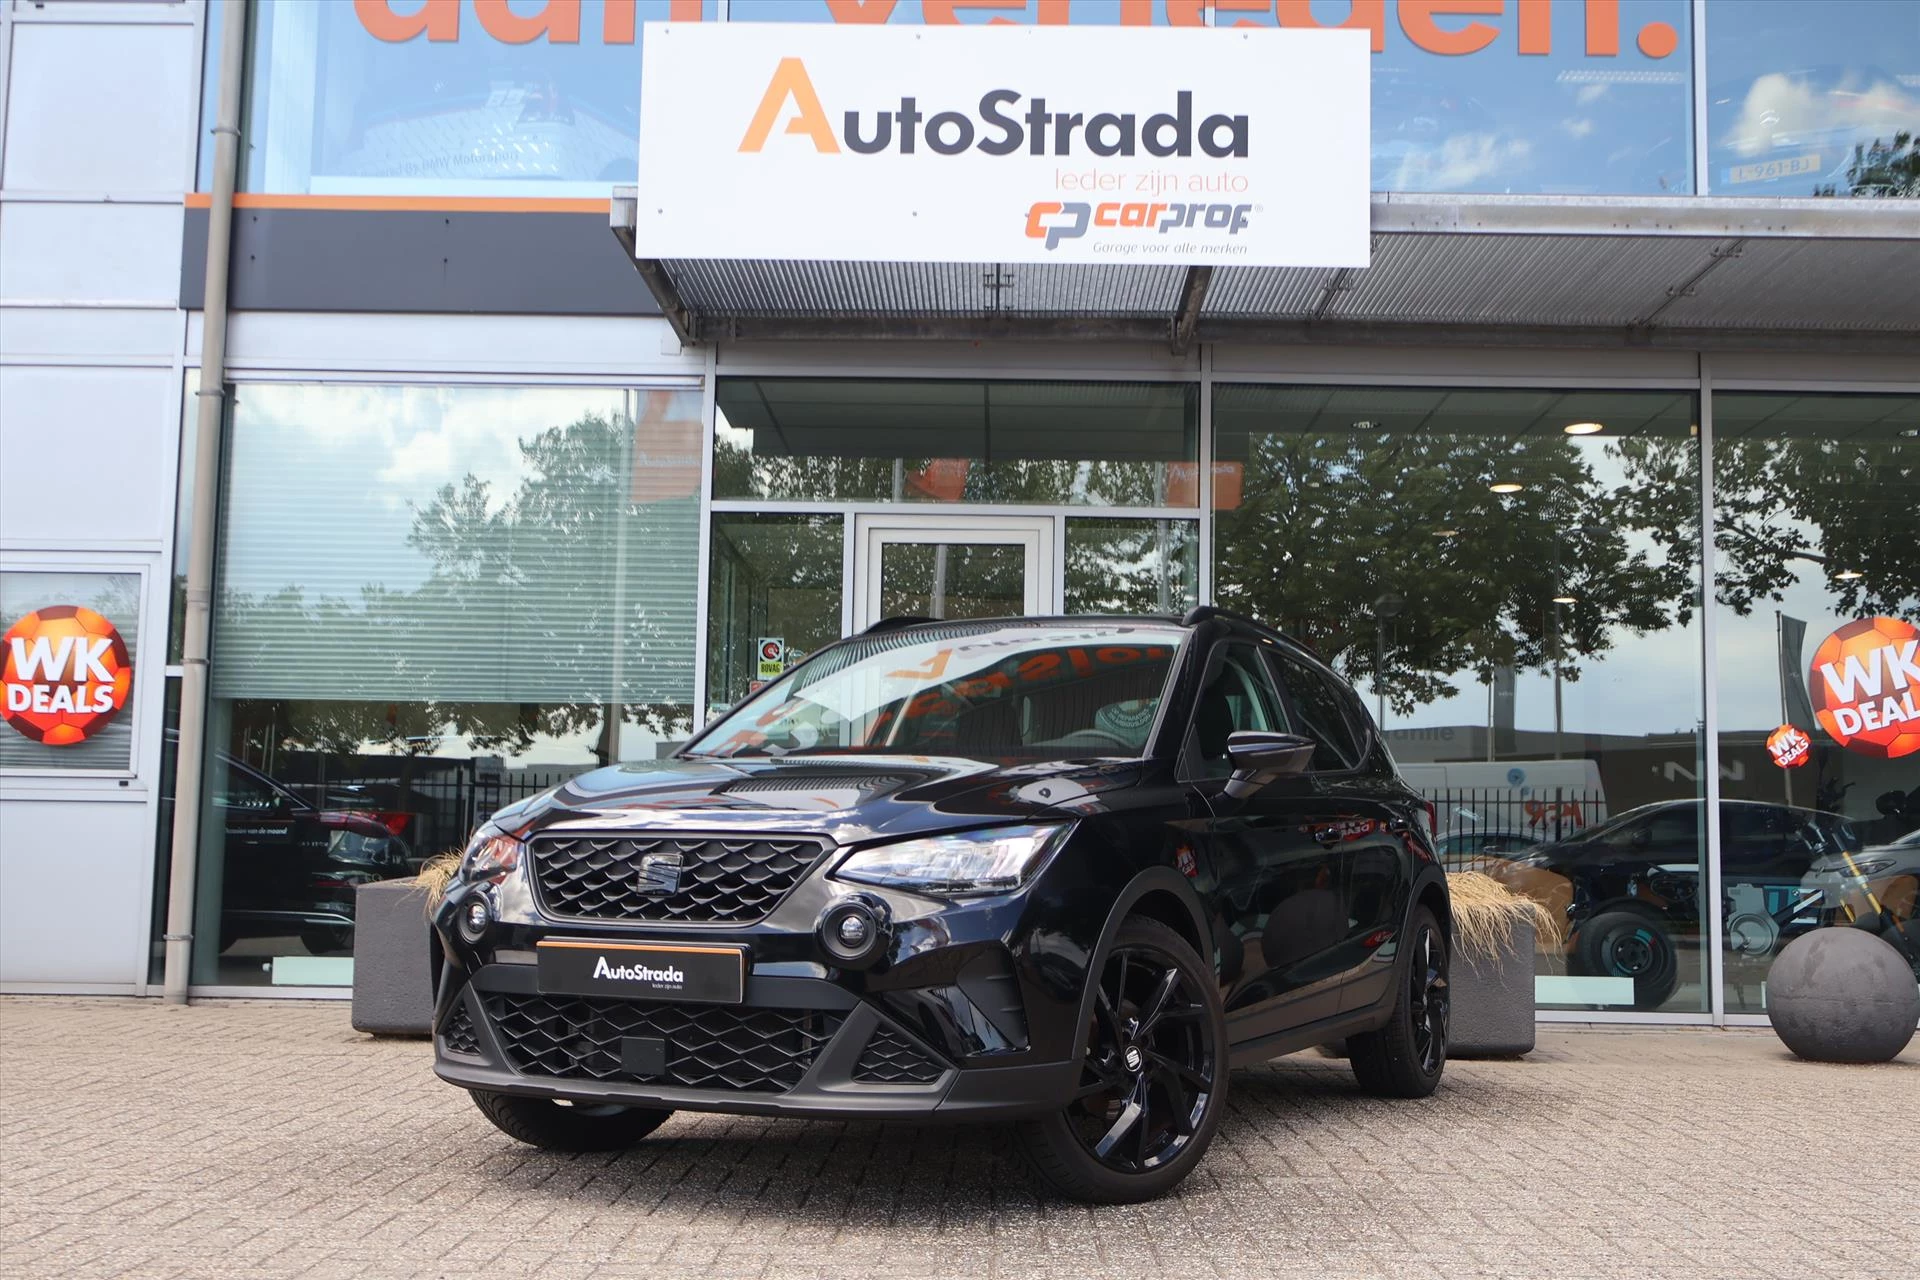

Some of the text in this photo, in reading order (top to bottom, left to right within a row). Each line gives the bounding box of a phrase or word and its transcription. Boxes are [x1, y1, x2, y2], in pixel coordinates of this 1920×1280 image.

[737, 57, 1249, 158] AutoStrada
[1055, 168, 1249, 197] Ieder zijn auto
[1093, 242, 1248, 256] Garage voor alle merken
[10, 635, 116, 682] WK
[1820, 639, 1920, 704] WK
[7, 683, 115, 714] DEALS
[1768, 728, 1803, 757] WK
[1778, 738, 1810, 766] DEALS
[592, 956, 684, 983] AutoStrada
